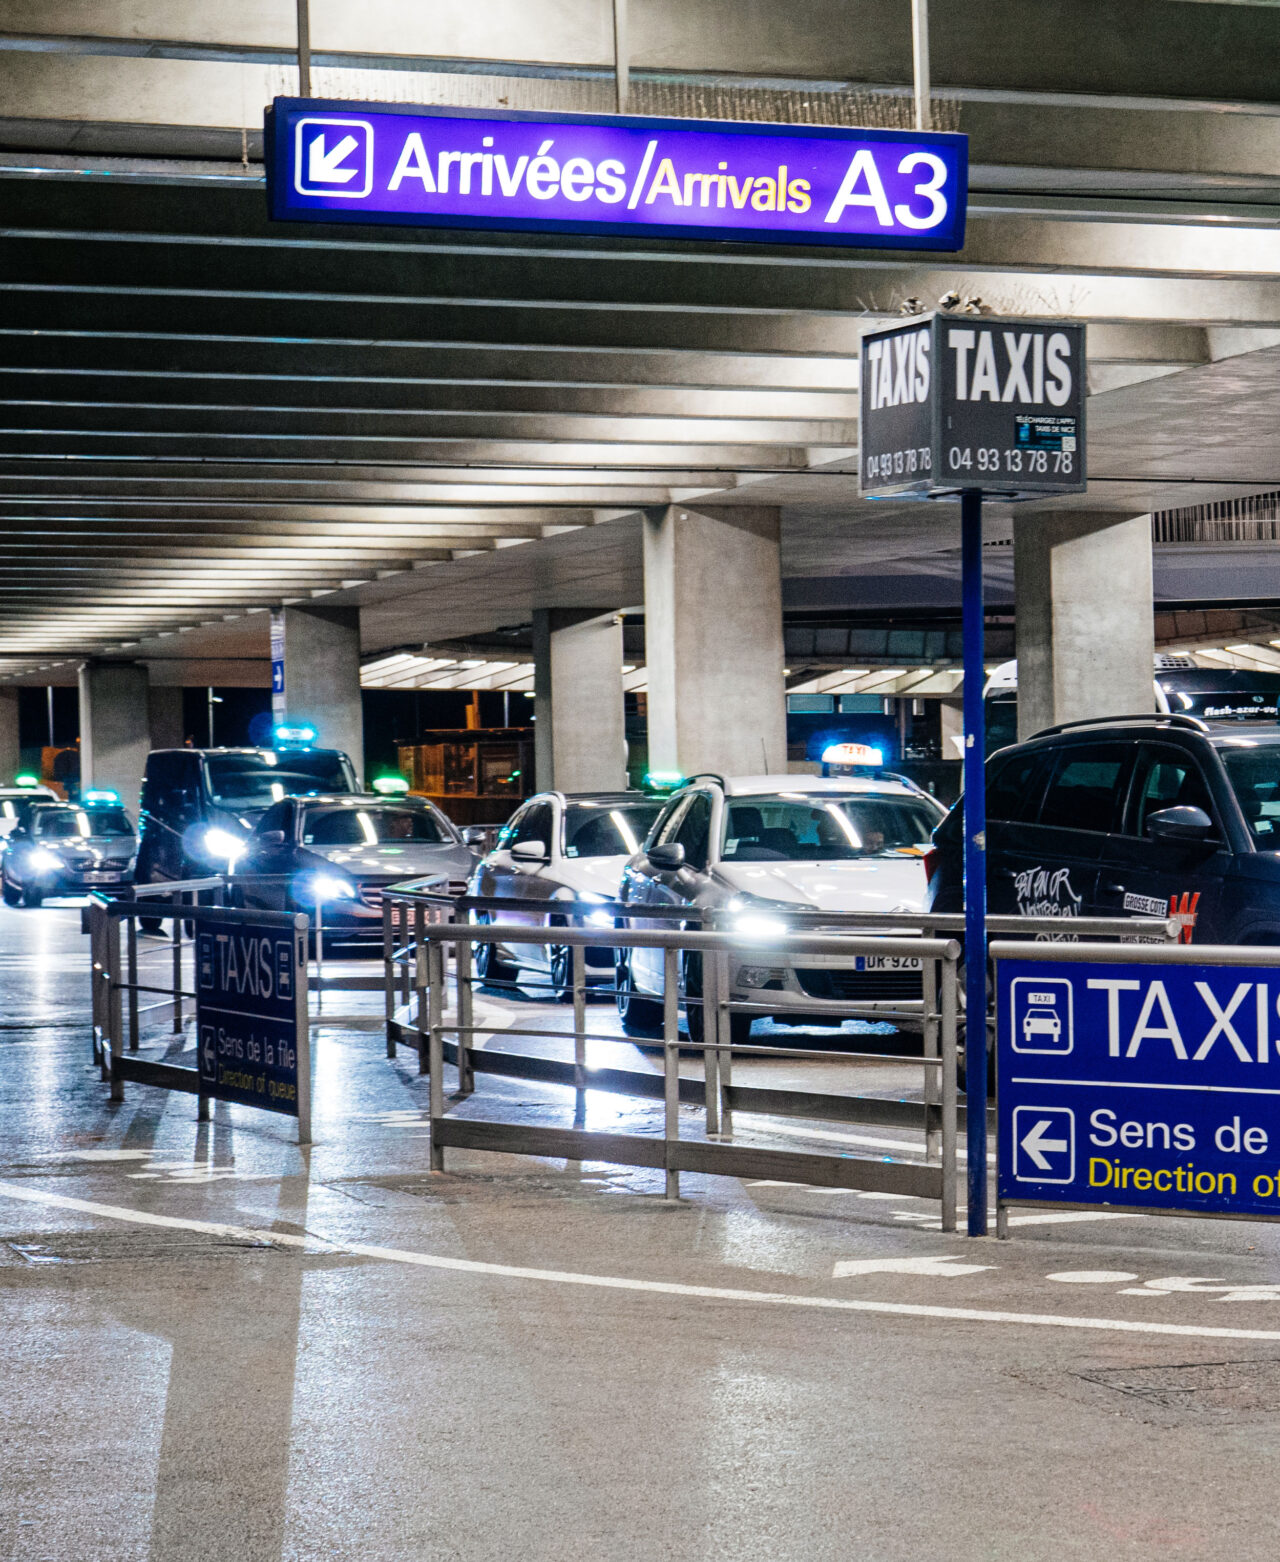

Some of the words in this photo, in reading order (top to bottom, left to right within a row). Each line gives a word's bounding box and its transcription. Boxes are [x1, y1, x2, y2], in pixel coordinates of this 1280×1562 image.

[824, 149, 948, 230] A3
[868, 328, 931, 410] TAXIS
[948, 329, 1072, 407] TAXIS
[867, 456, 880, 478] 04
[880, 453, 892, 476] 93
[893, 451, 904, 473] 13
[904, 449, 918, 472] 78
[918, 447, 931, 470] 78
[949, 447, 973, 470] 04
[977, 448, 1000, 471] 93
[1004, 449, 1022, 472] 13
[1026, 450, 1047, 473] 78
[1051, 451, 1073, 474] 78
[1126, 895, 1149, 911] GROSSE
[216, 935, 273, 998] TAXIS
[1033, 994, 1052, 1003] TAXI
[218, 1028, 244, 1058] Sens
[247, 1033, 260, 1062] de
[264, 1036, 274, 1065] la
[278, 1039, 295, 1069] file
[219, 1063, 254, 1091] Direction
[256, 1072, 266, 1093] of
[269, 1080, 296, 1101] queue
[1089, 1109, 1196, 1151] Sens
[1215, 1116, 1268, 1155] de
[1088, 1157, 1237, 1195] Direction
